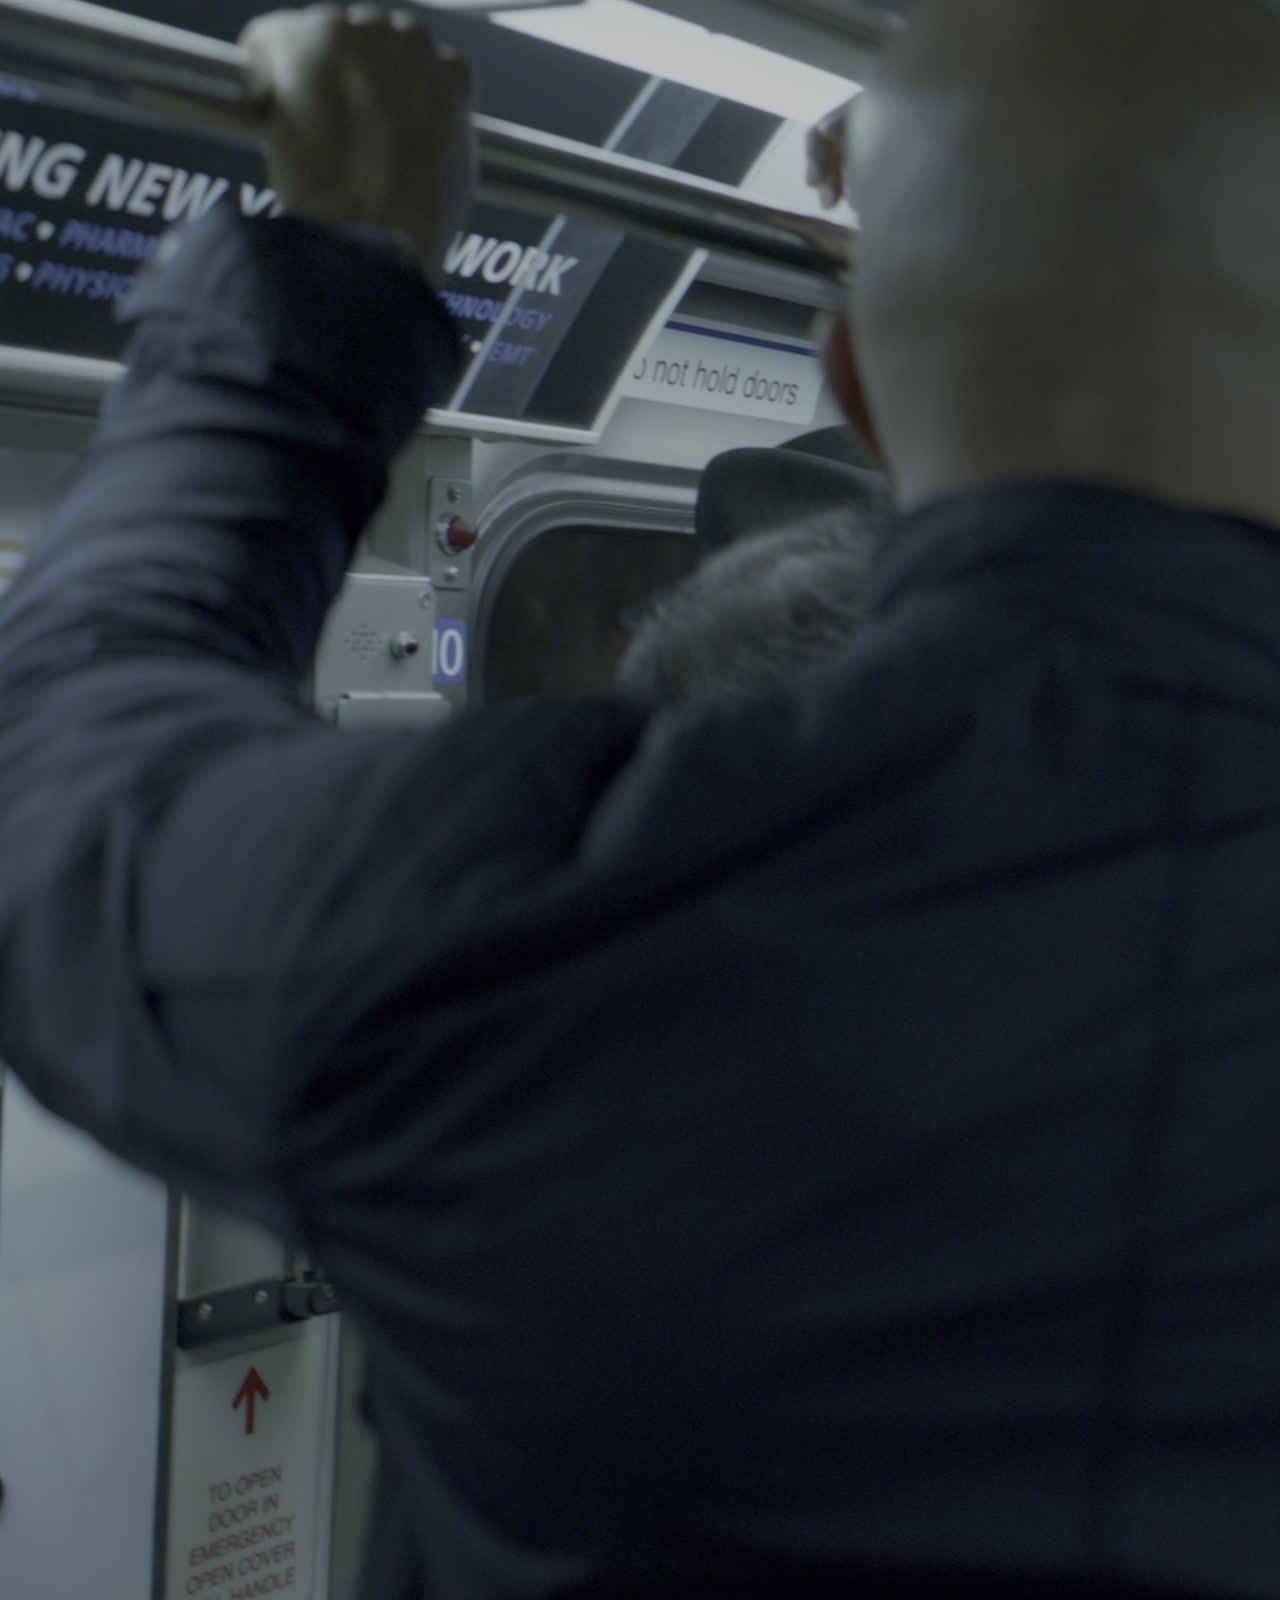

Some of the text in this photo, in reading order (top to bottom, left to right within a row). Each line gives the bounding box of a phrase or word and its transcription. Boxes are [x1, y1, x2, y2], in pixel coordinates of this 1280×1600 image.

[85, 152, 230, 222] NEW
[442, 231, 580, 296] WORK
[652, 358, 689, 388] not
[692, 359, 742, 396] hold
[742, 369, 799, 406] doors
[208, 1465, 283, 1504] TO OPEN
[208, 1493, 279, 1532] DOOR IN
[189, 1513, 296, 1567] EMERGENCY
[184, 1540, 296, 1595] OPEN COVER
